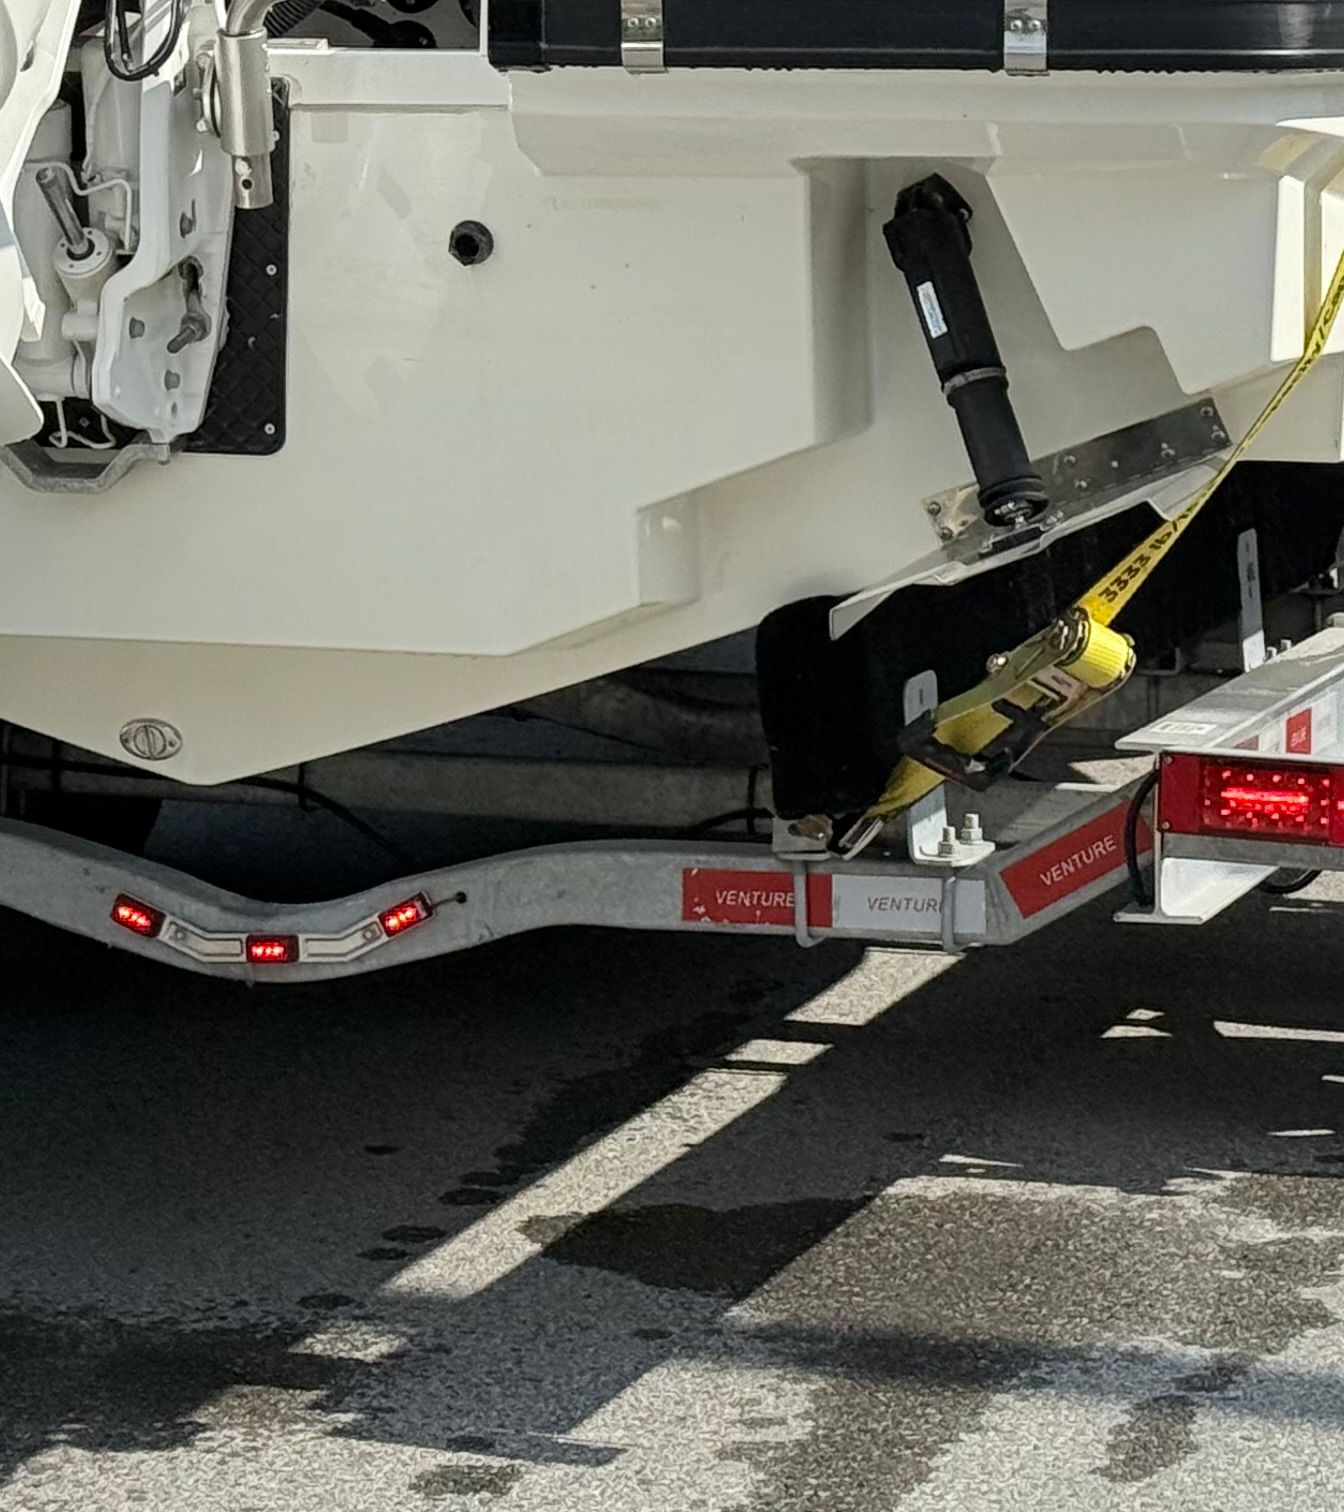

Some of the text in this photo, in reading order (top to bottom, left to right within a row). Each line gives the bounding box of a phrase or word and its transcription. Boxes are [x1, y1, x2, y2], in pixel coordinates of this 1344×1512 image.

[1097, 553, 1152, 604] 3333
[1039, 834, 1118, 886] VENTURE
[715, 889, 796, 908] VENTURE
[867, 896, 944, 914] VENTUR
